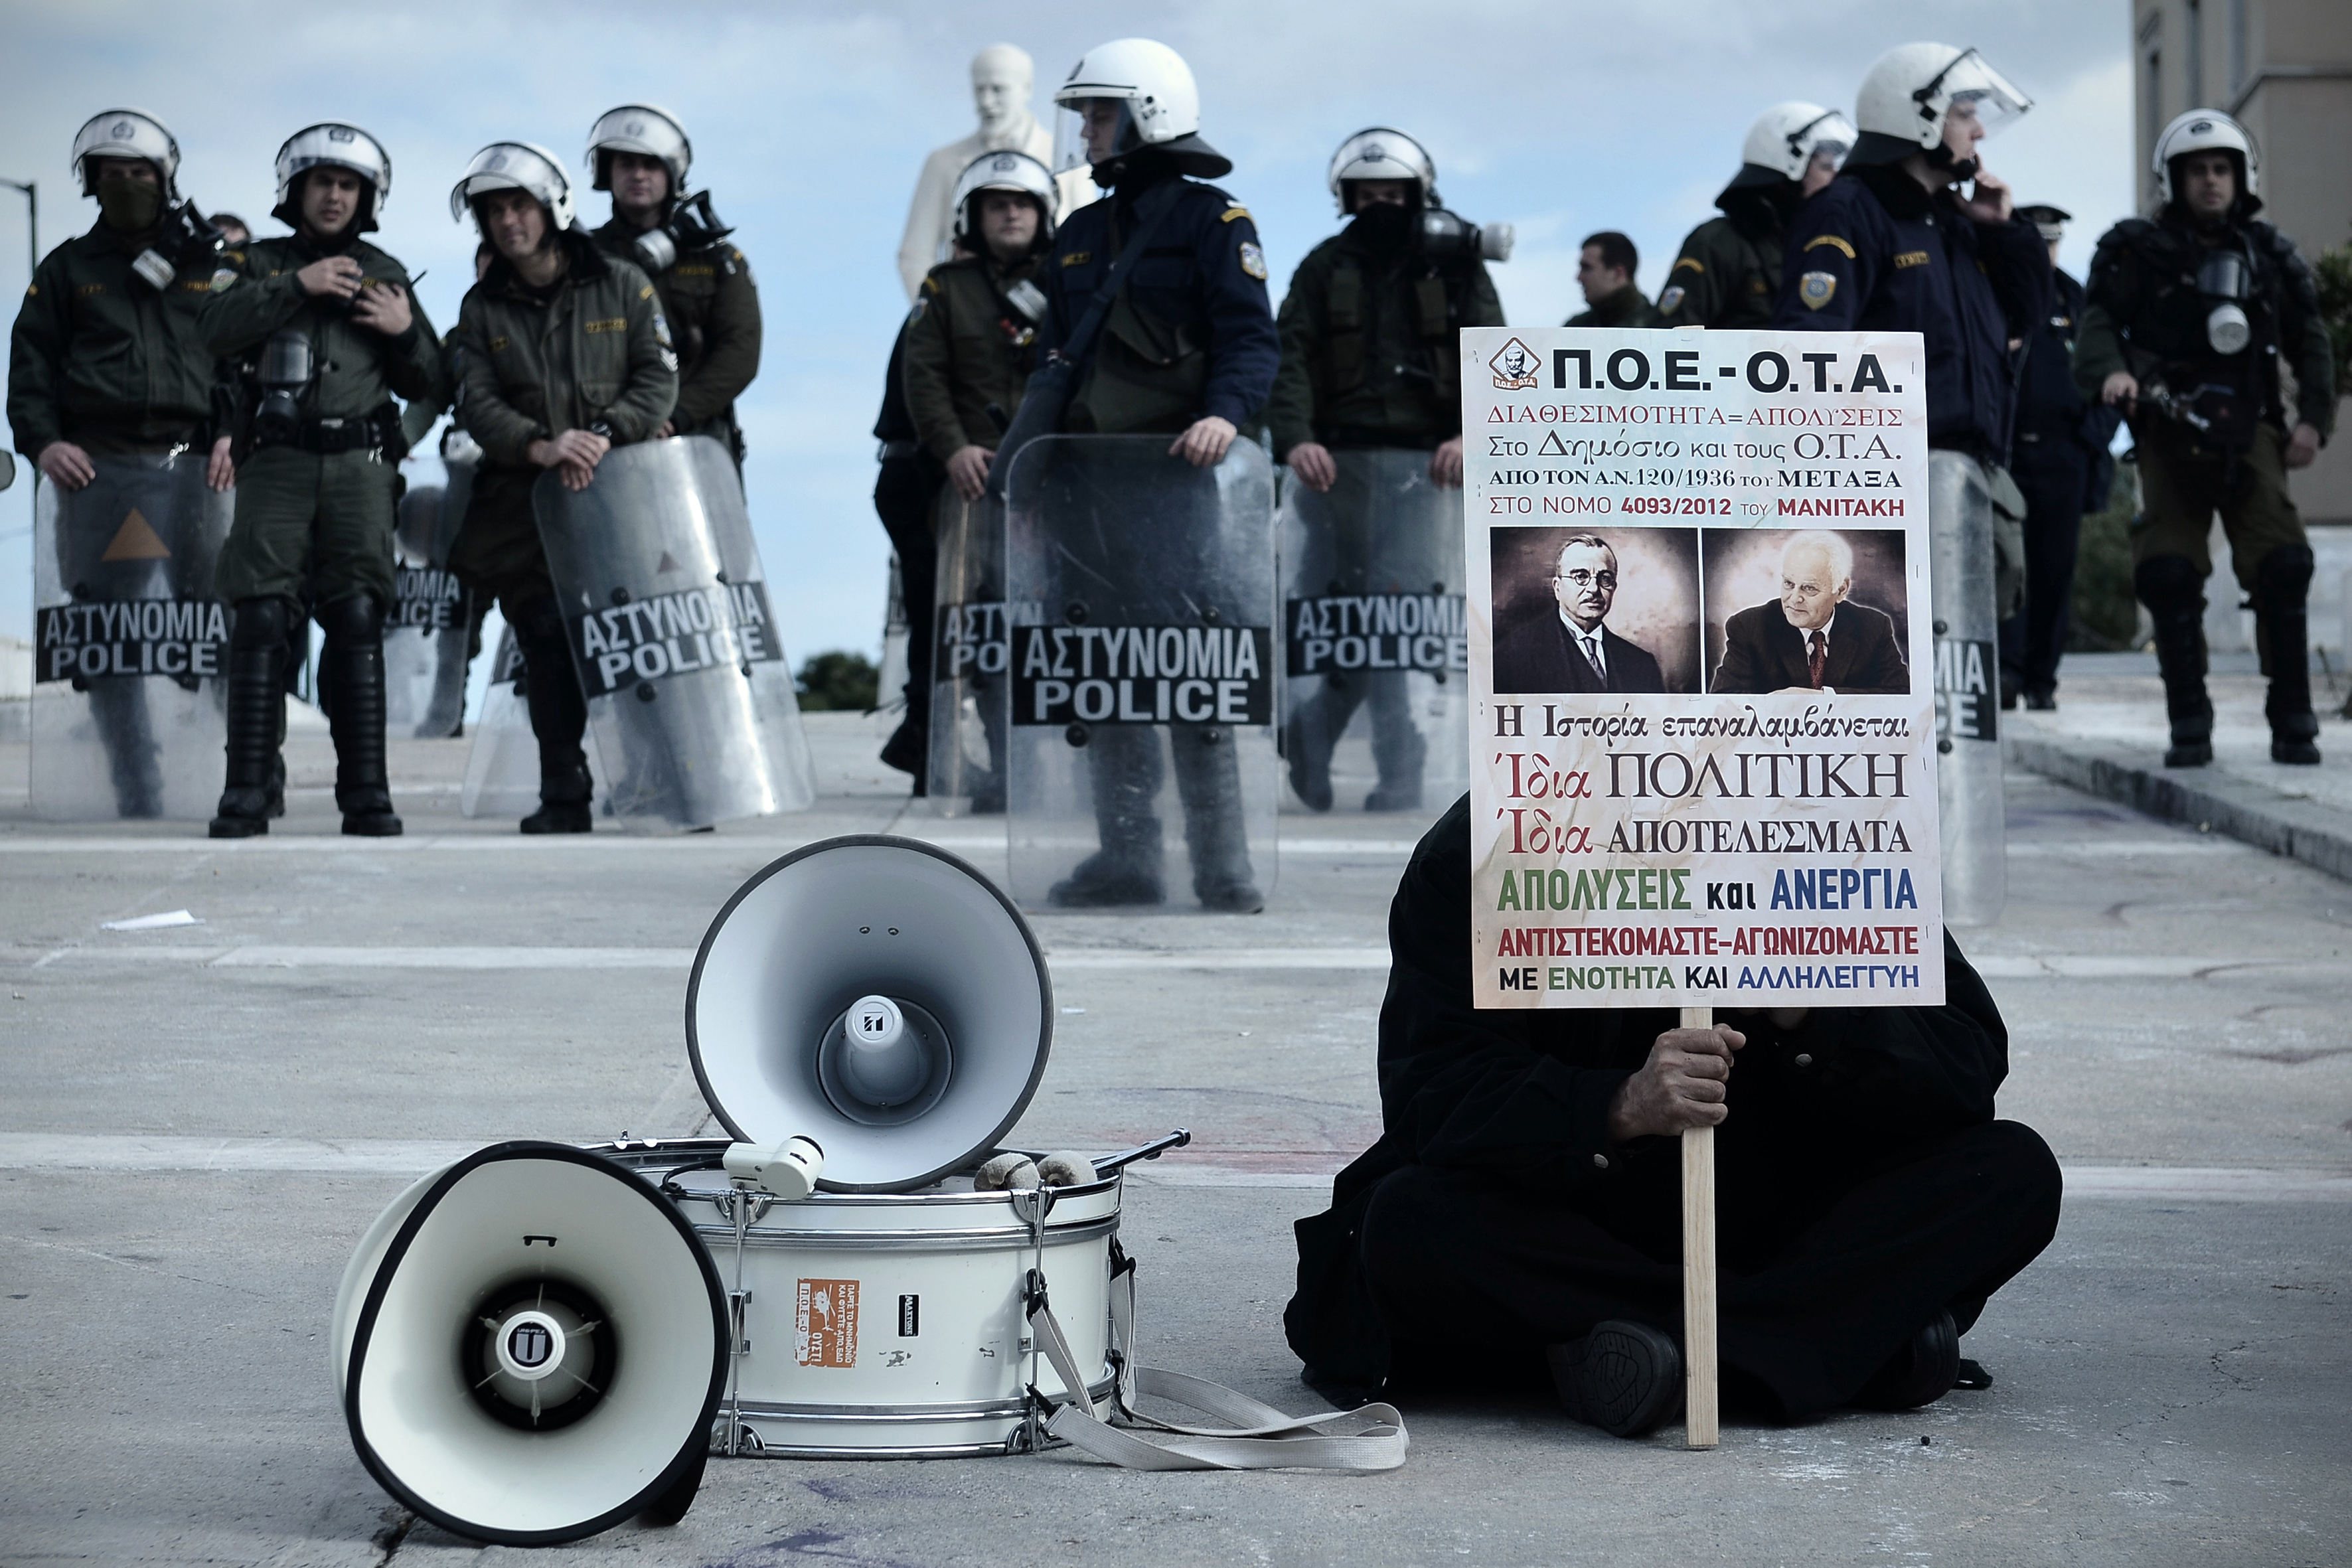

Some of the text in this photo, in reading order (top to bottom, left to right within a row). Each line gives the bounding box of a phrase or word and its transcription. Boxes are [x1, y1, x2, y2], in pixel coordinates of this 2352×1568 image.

[1488, 428, 1902, 465] Στο Δημόσιο και τους Ο.Τ.Α.
[1488, 469, 1539, 485] ΑΠΟ
[1543, 469, 1590, 485] ΤΟΝ
[1636, 468, 1735, 488] 120/1936
[1776, 469, 1903, 488] ΜΕΤΑΞΑ
[1490, 497, 1905, 516] ΣΤΟ ΝΟΜΟ 4093/2012 ΤΟΥ ΜΑΝΙΤΑΚΗ
[44, 600, 228, 649] ΑΣΤΥΝΟΜΙΑ
[582, 583, 764, 659] ΑΣΤΥΝΟΜΙΑ
[51, 641, 219, 679] POLICE
[597, 625, 768, 690] POLICE
[1022, 626, 1260, 680] ΑΣΤΥΝΟΜΙΑ
[1304, 634, 1468, 671] POLICE
[1034, 679, 1249, 722] POLICE
[1494, 704, 1525, 737] Η
[1542, 702, 1649, 747] Ιστορία
[1662, 702, 1910, 748] επαναλαμβάνεται
[1494, 752, 1909, 799] Ίδια ΠΟΛΙΤΙΚΗ
[1496, 807, 1913, 854] Ίδια ΑΠΟΤΕΛΕΣΜΑΤΑ
[1497, 868, 1919, 911] ΑΠΟΛΥΣΕΙΣ και ΑΝΕΡΓΙΑ
[1499, 965, 1920, 990] ΜΕ ΕΝΟΤΗΤΑ ΚΑΙ ΑΛΛΗΛΕΓΓΥΗ
